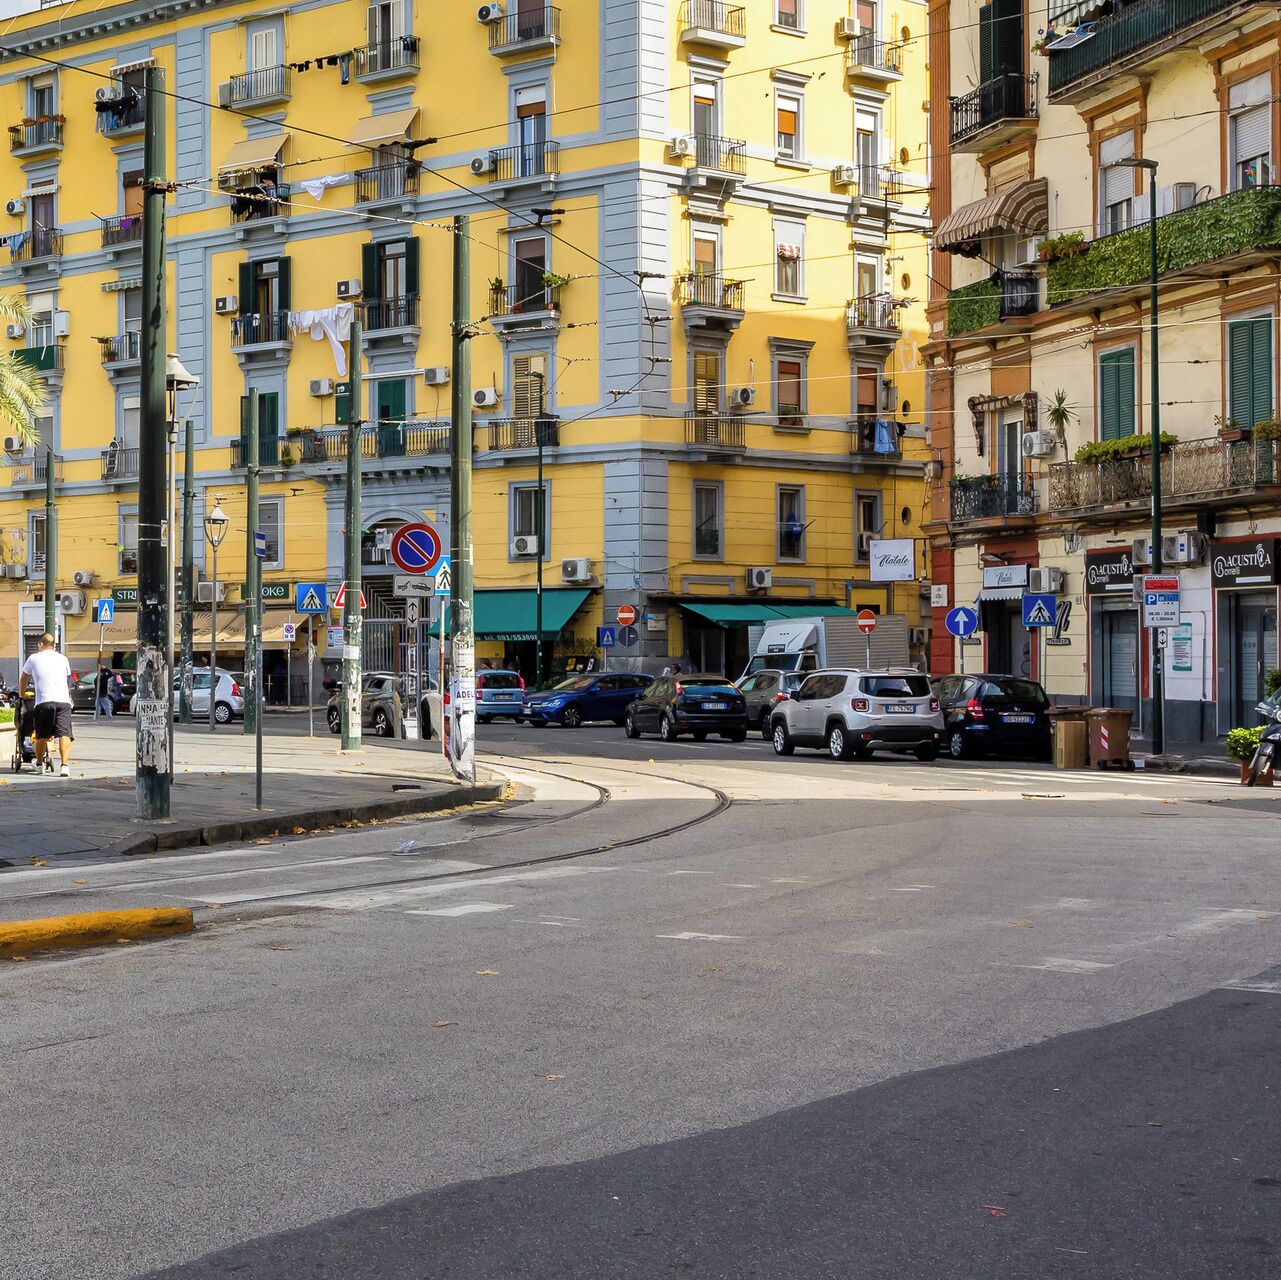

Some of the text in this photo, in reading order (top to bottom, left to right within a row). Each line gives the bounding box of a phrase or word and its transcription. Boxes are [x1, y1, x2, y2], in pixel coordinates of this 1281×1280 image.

[874, 554, 909, 567] Natale
[1227, 549, 1272, 567] ACUSTICA
[1098, 559, 1134, 576] ACUSTICA
